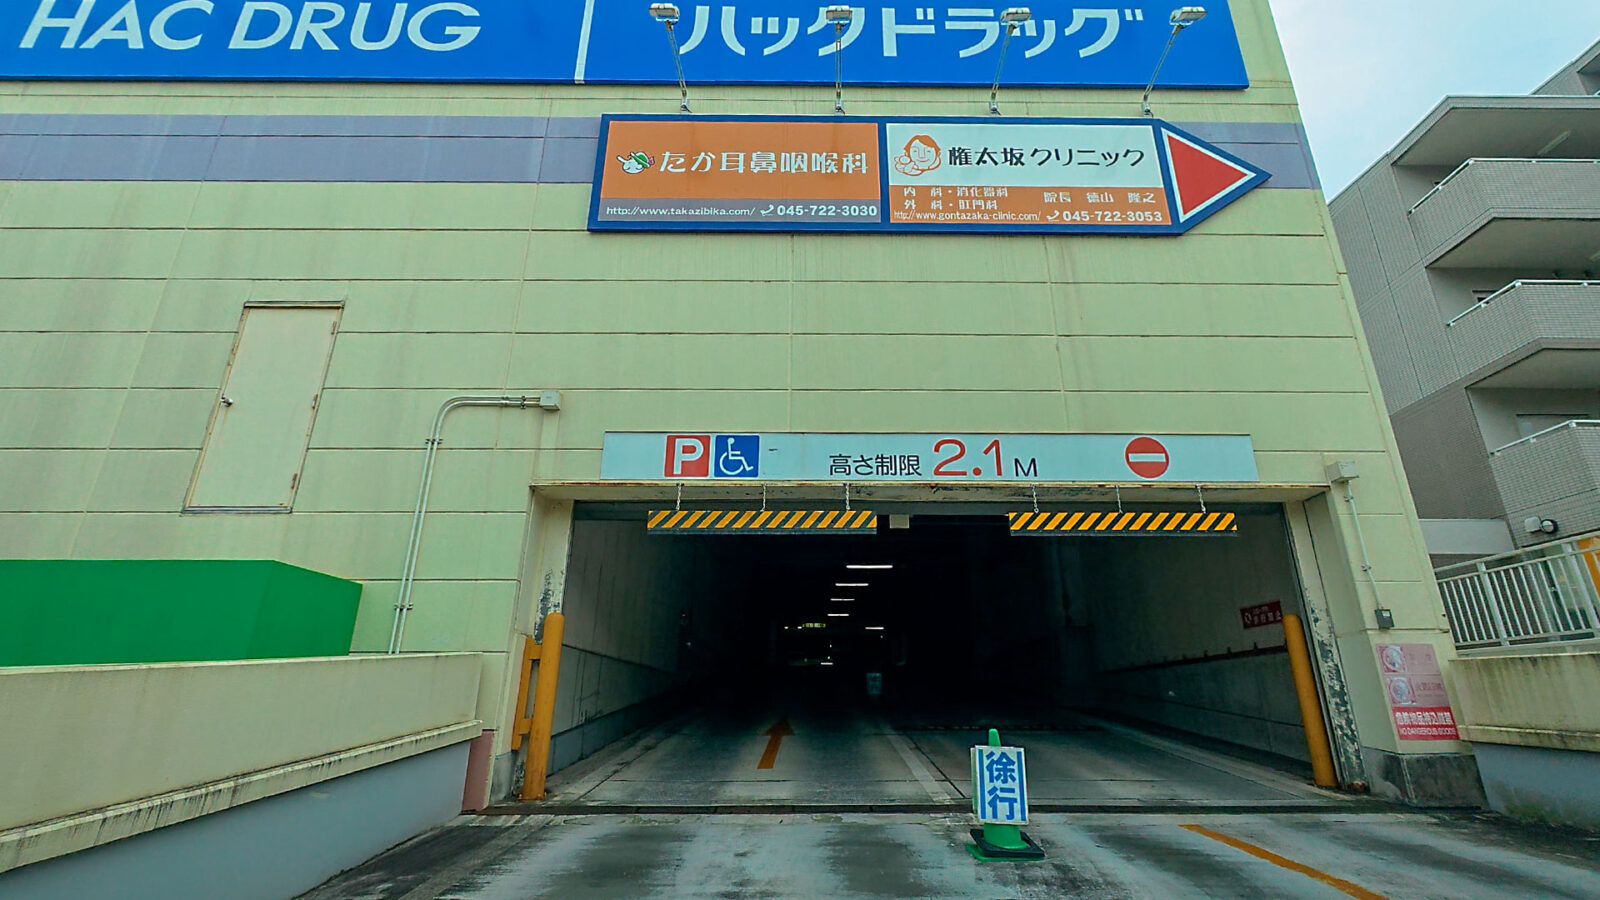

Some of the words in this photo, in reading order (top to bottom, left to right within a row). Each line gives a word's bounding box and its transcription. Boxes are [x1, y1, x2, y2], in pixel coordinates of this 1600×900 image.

[18, 0, 215, 50] HAC
[227, 1, 482, 51] DRUG
[679, 5, 1145, 59] ハックドラッグ
[659, 151, 869, 175] たか耳鼻咽喉科
[948, 146, 1145, 167] 権太坂クリニック
[1043, 191, 1073, 203] 院長
[606, 206, 756, 216] http://www.takazibika.com/
[776, 204, 878, 216] 045-722-3030
[893, 209, 1041, 221] http://www.gontazaka-clinic.com/
[1062, 210, 1163, 222] 045-722-3053
[673, 438, 704, 475] P
[829, 453, 922, 477] 高さ制限
[933, 438, 1003, 477] 2.1
[1014, 457, 1038, 477] M
[985, 750, 1018, 821] 徐行
